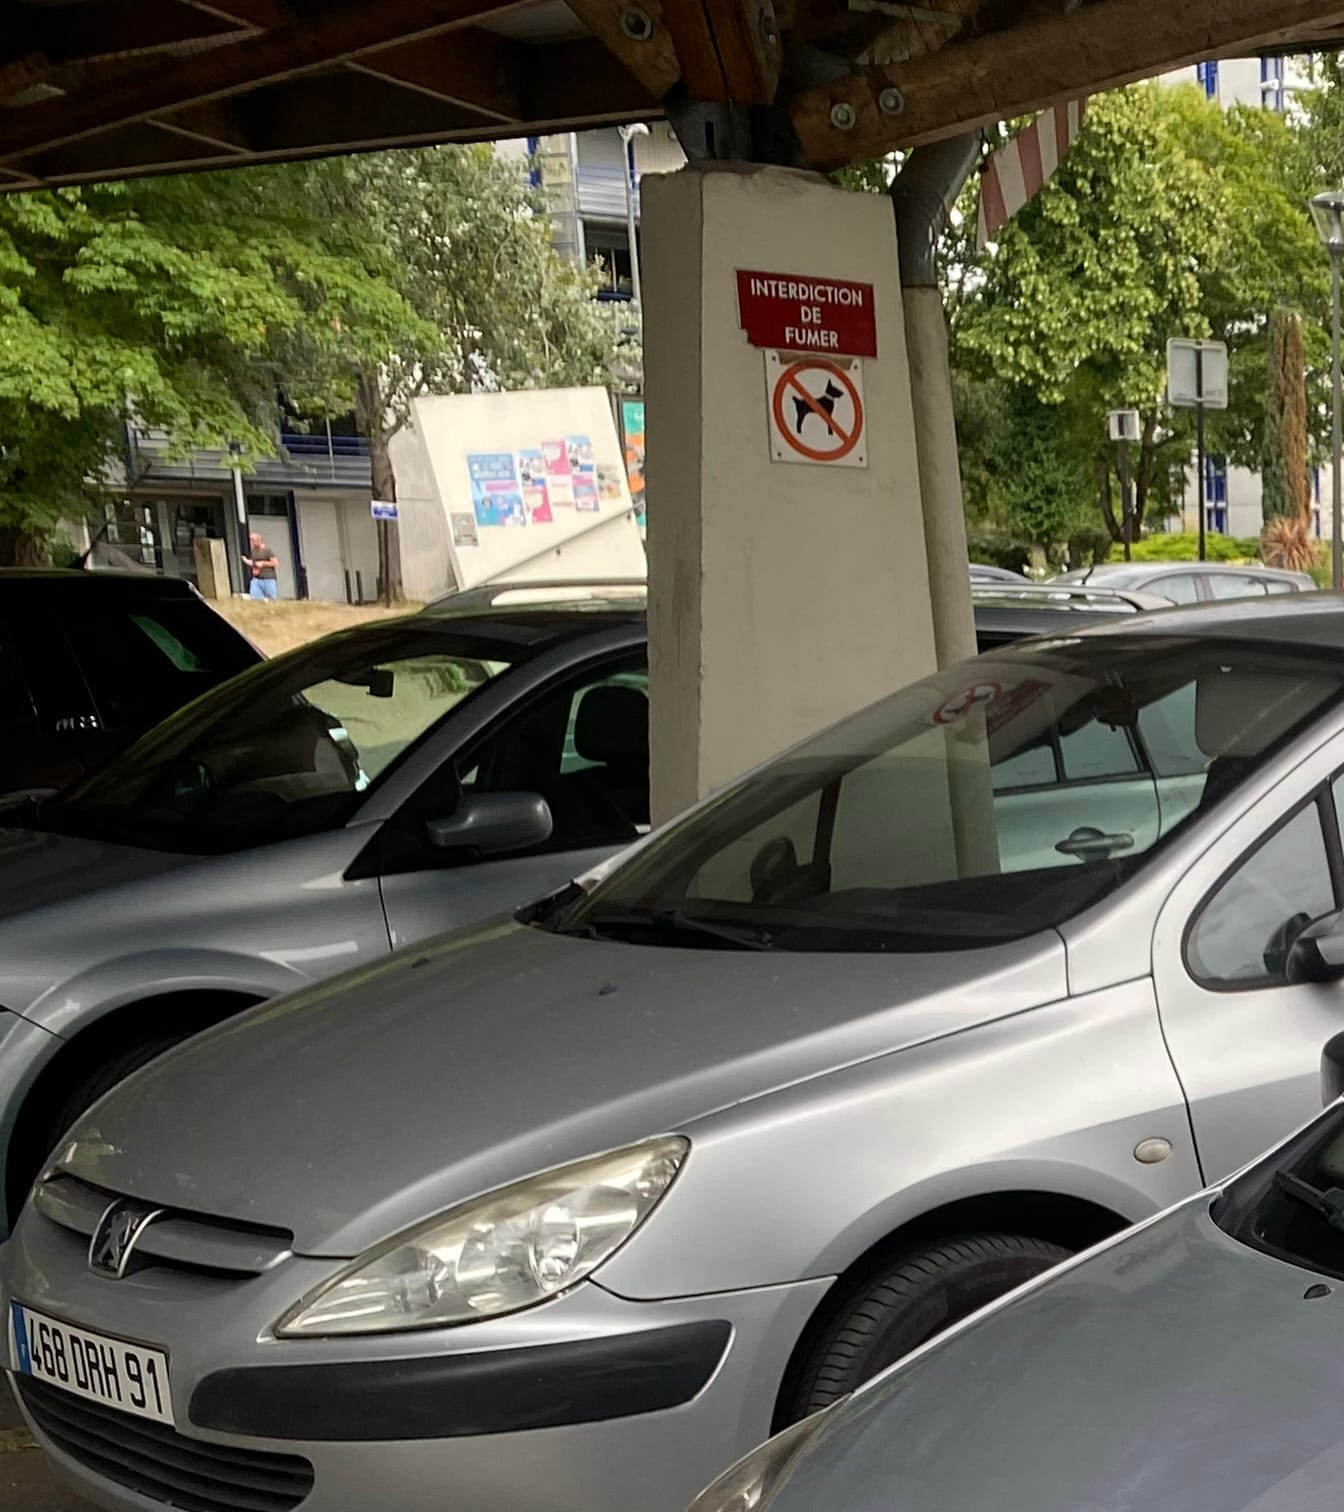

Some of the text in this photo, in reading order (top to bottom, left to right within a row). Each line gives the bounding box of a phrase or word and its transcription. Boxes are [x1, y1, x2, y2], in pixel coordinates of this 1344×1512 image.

[750, 278, 863, 307] INTERDICTION
[800, 305, 822, 324] DE
[785, 326, 839, 348] FUMER
[29, 1317, 69, 1383] 468
[68, 1334, 122, 1402] DRH
[124, 1351, 164, 1414] 91
